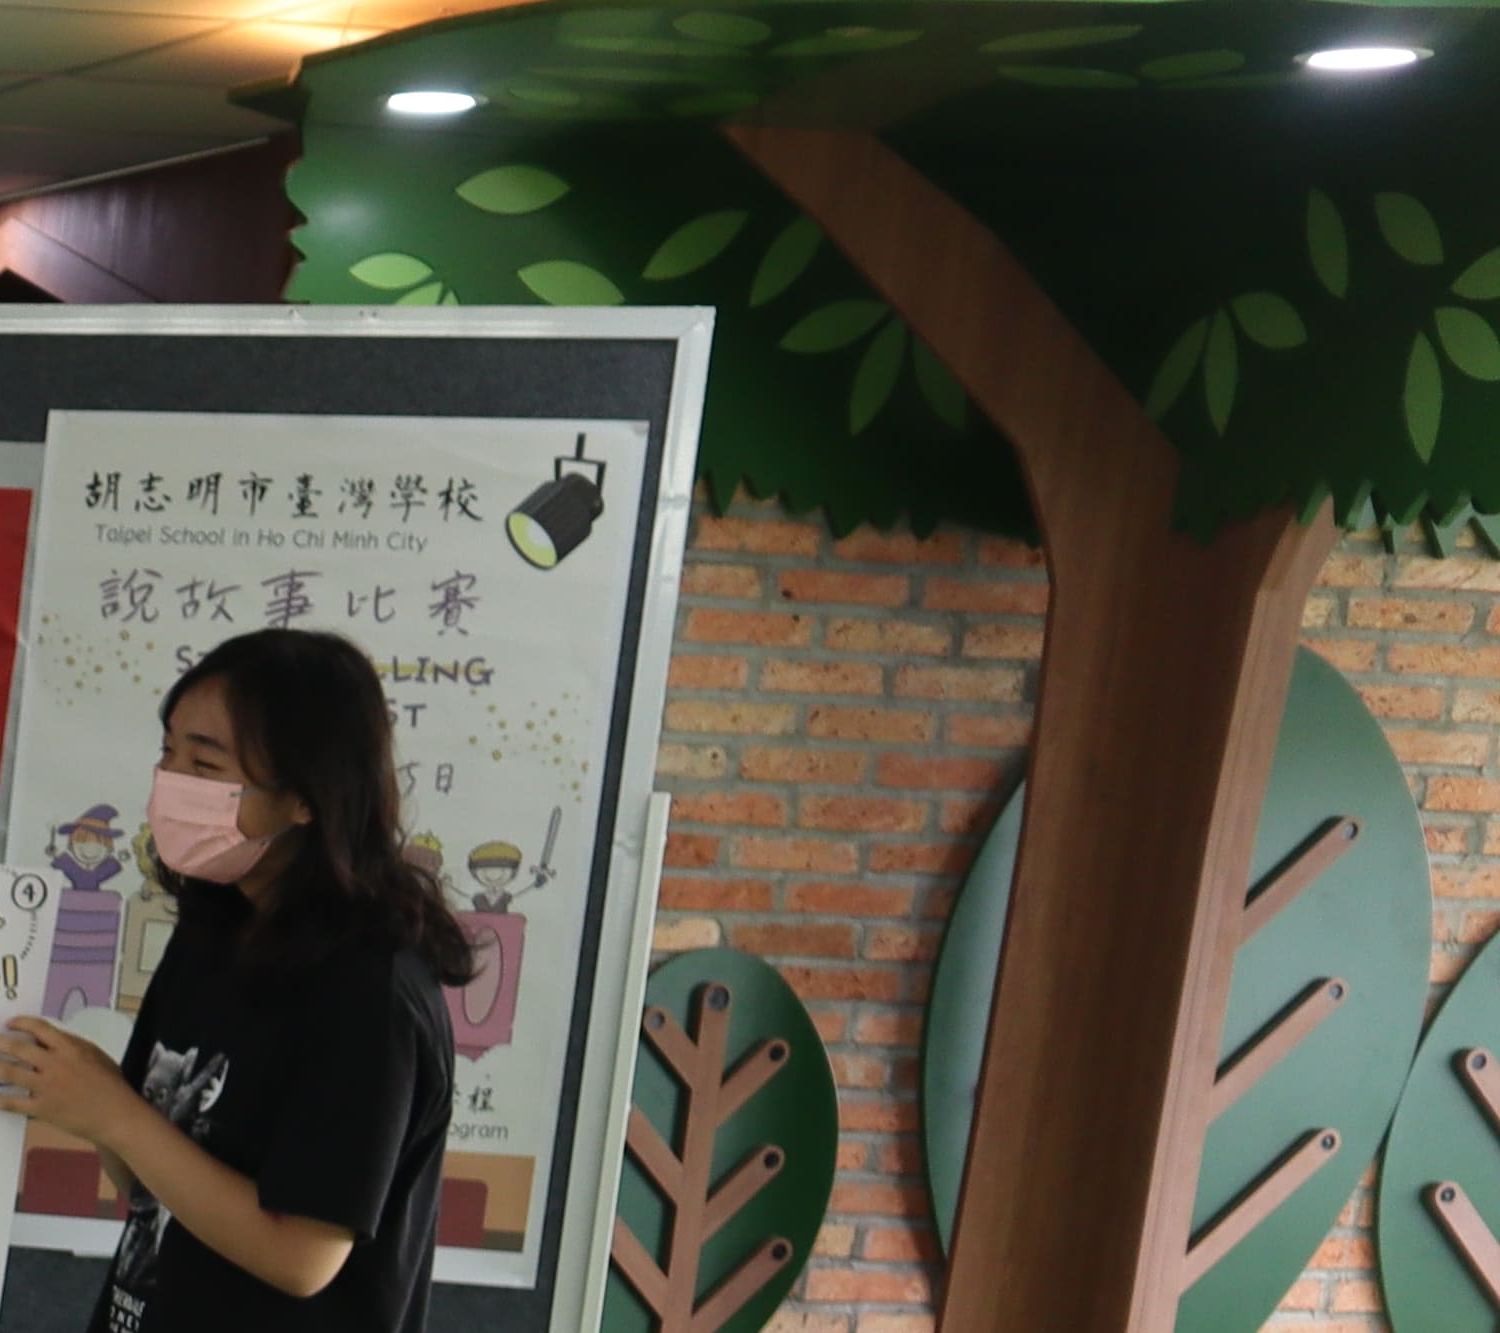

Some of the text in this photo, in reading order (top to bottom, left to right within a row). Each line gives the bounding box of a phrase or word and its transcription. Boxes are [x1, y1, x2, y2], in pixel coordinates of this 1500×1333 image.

[84, 472, 483, 524] 胡志明市臺灣學校
[95, 524, 429, 553] Taipei School in Ho Chi Minh City
[98, 568, 481, 637] 說故事比賽
[378, 655, 494, 686] LING
